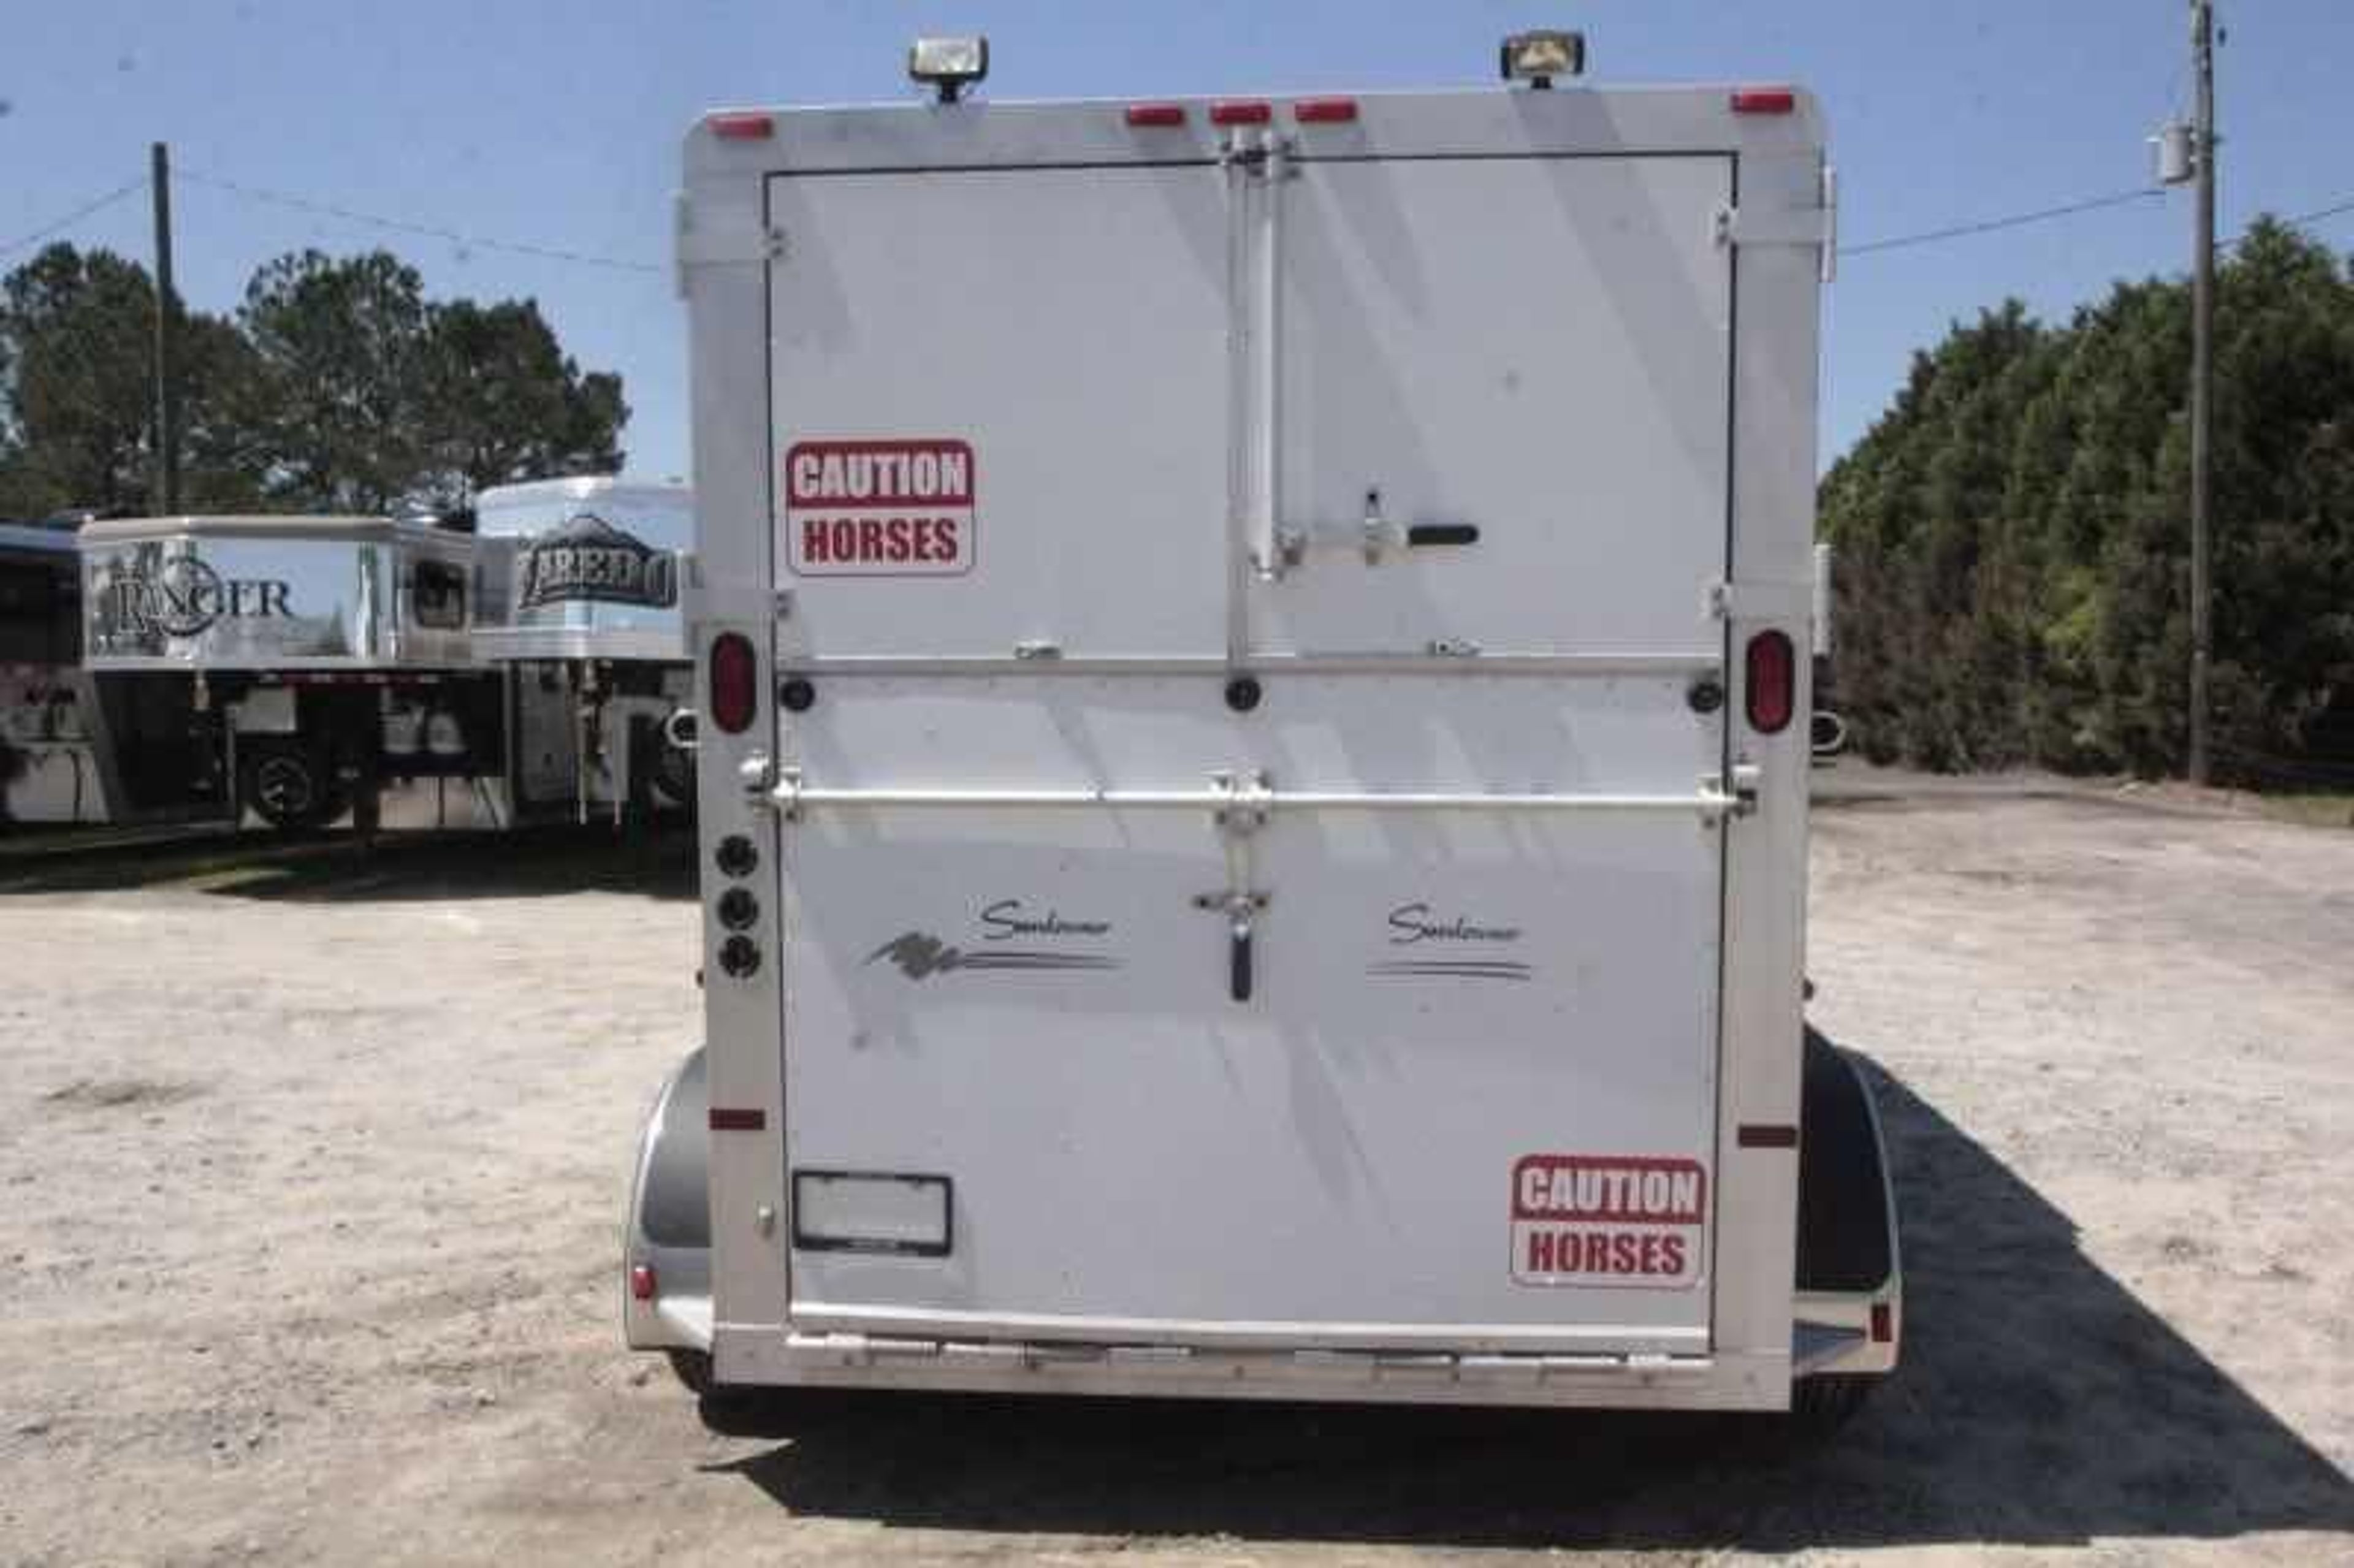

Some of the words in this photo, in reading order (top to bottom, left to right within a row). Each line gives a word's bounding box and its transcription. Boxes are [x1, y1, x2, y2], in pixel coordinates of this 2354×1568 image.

[794, 452, 966, 498] CAUTION
[802, 519, 958, 563] HORSES
[1520, 1168, 1697, 1214] CAUTION
[1528, 1231, 1685, 1274] HORSES
